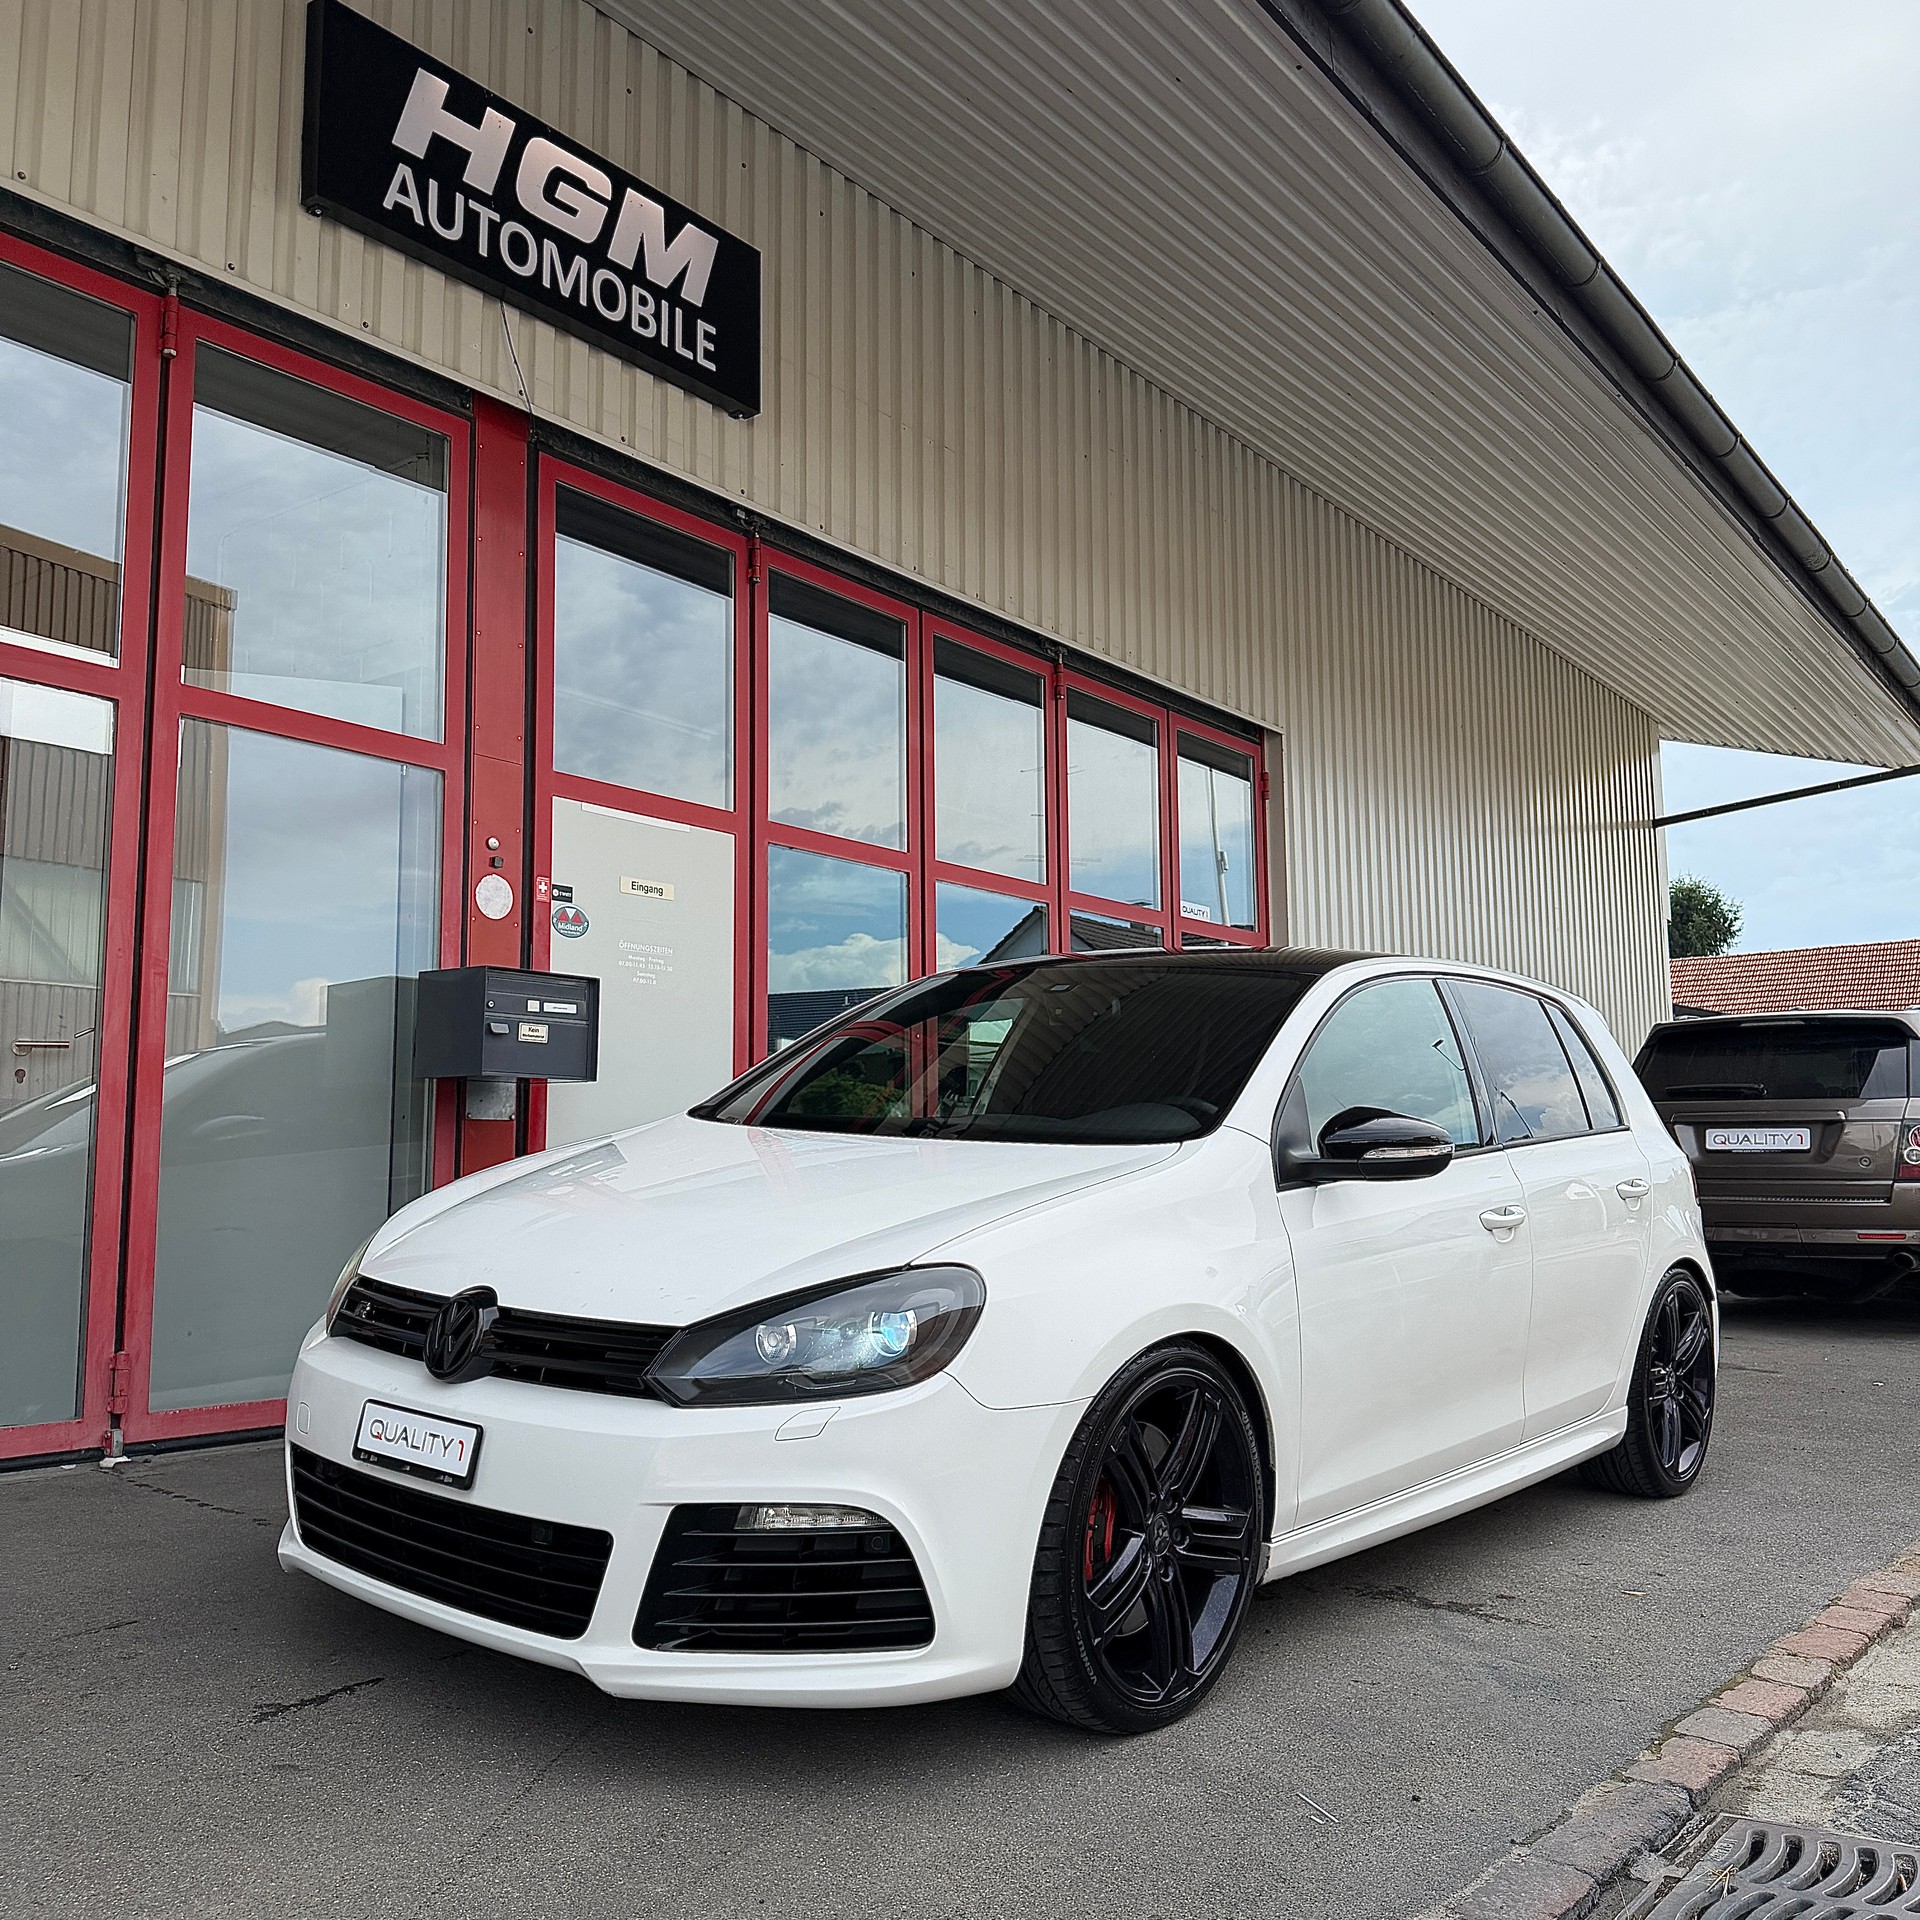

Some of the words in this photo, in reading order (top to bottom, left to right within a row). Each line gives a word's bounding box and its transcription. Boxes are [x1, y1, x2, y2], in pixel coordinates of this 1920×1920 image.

[391, 67, 719, 307] HGM
[382, 162, 717, 372] AUTOMOBILE
[558, 921, 583, 932] Midland
[631, 881, 664, 897] Eingang
